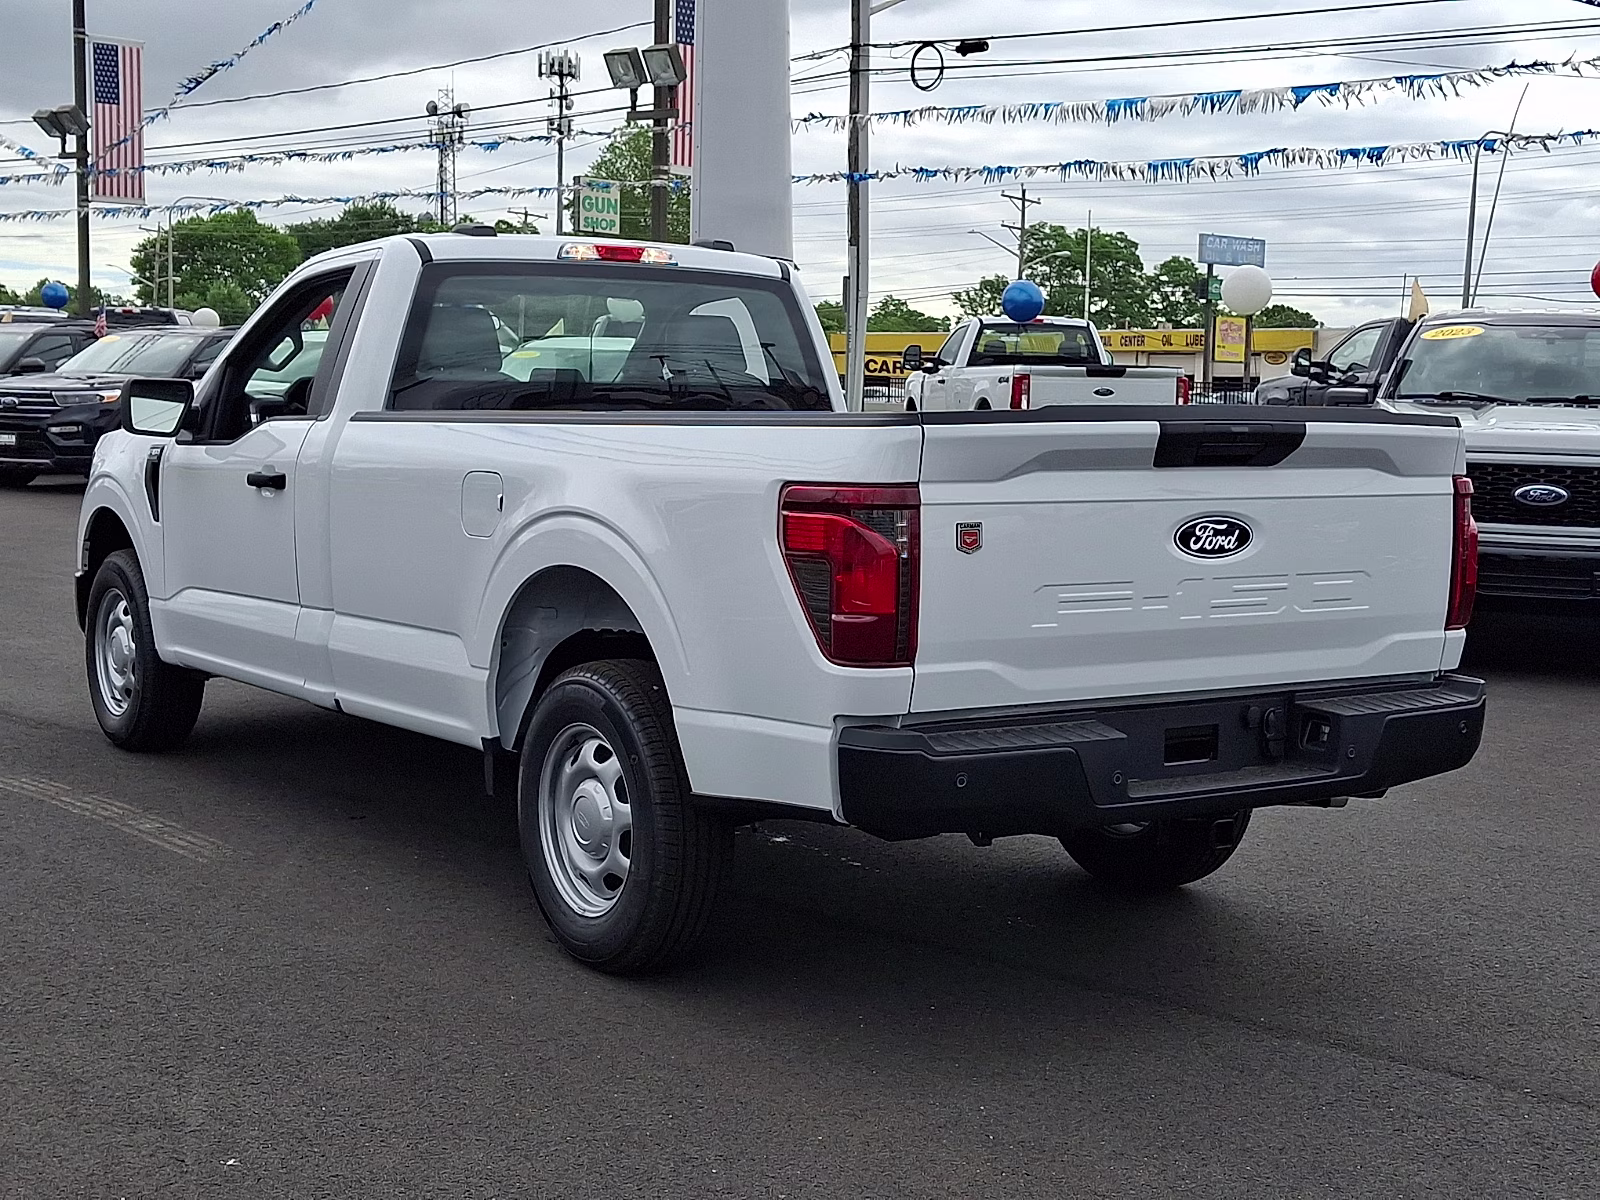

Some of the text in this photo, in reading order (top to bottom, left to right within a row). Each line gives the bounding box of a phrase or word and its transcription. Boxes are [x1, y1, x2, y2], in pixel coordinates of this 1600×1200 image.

[582, 195, 618, 215] GUN
[583, 216, 617, 231] SHOP
[1206, 237, 1261, 252] CAR WASH
[1205, 250, 1221, 262] OIL
[1119, 335, 1146, 347] CENTER
[1161, 334, 1174, 347] OIL
[1185, 334, 1205, 347] LUBE
[1430, 328, 1475, 338] 2023
[865, 358, 905, 374] CAR
[1527, 489, 1556, 501] Ford
[1190, 522, 1239, 550] Ford
[1031, 570, 1372, 628] F-150
